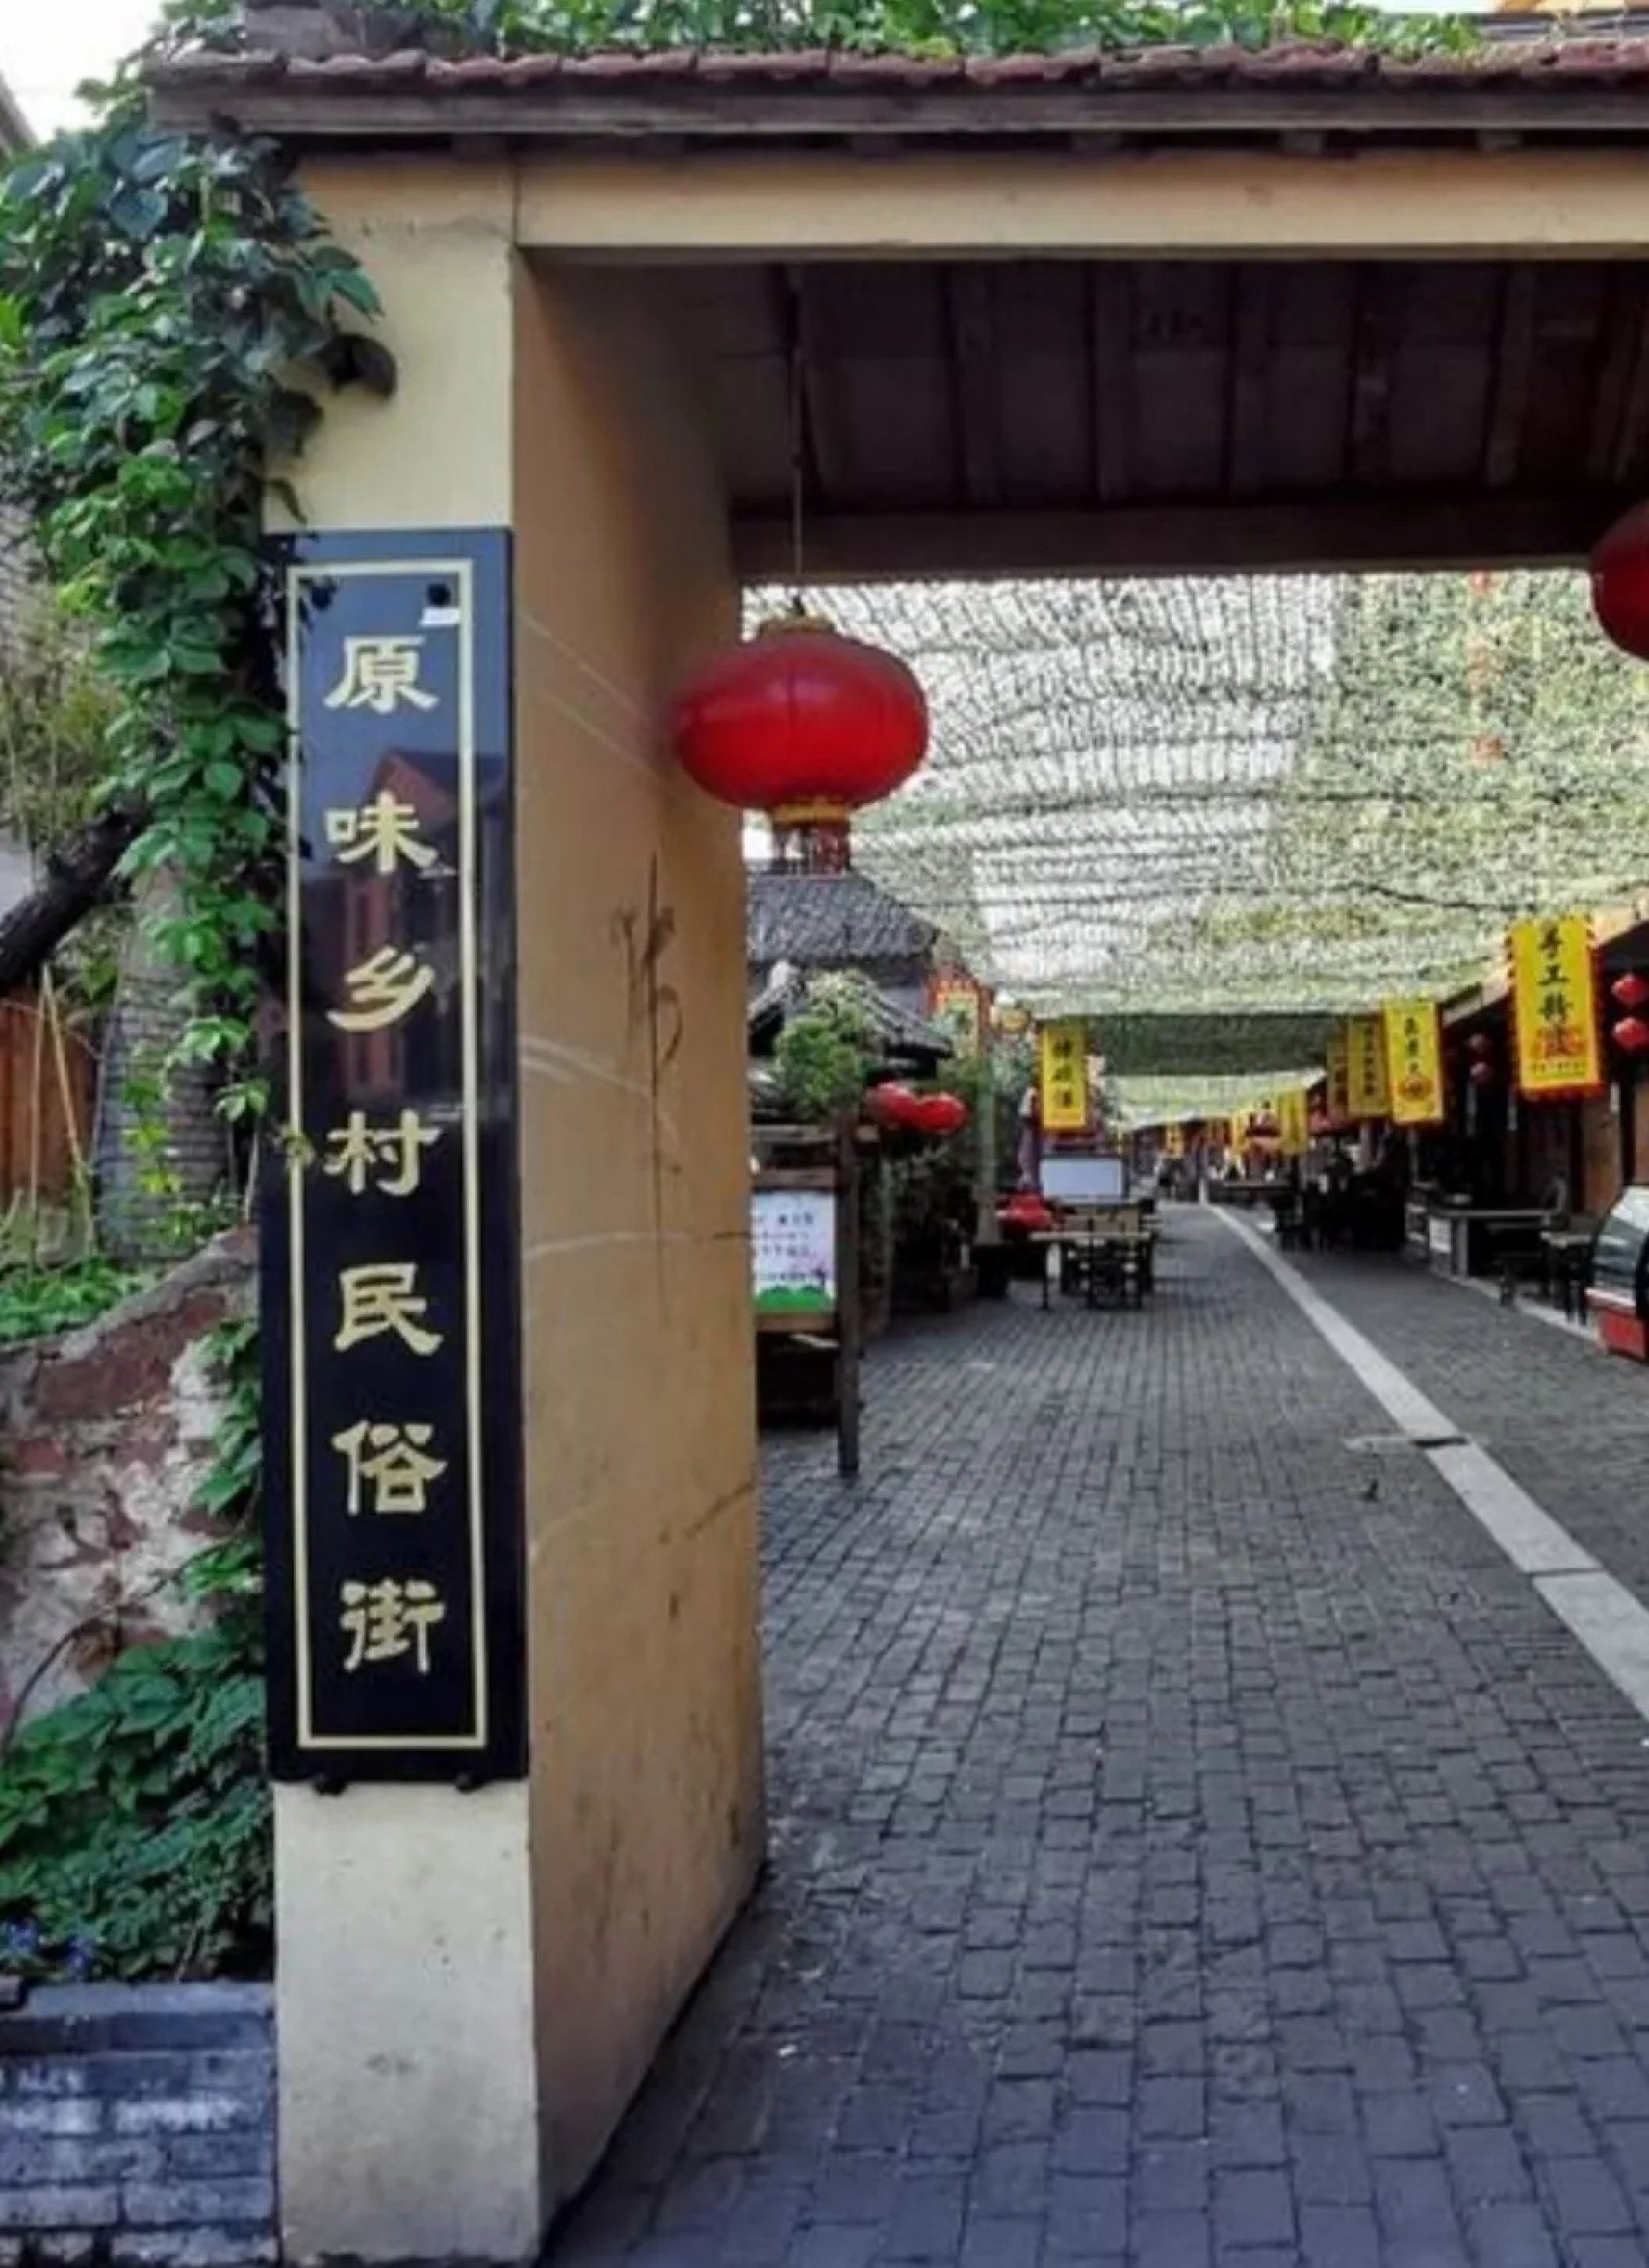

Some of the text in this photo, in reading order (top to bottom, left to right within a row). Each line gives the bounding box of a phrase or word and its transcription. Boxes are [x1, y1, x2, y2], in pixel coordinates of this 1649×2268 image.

[324, 635, 448, 1672] 原味乡村民俗街
